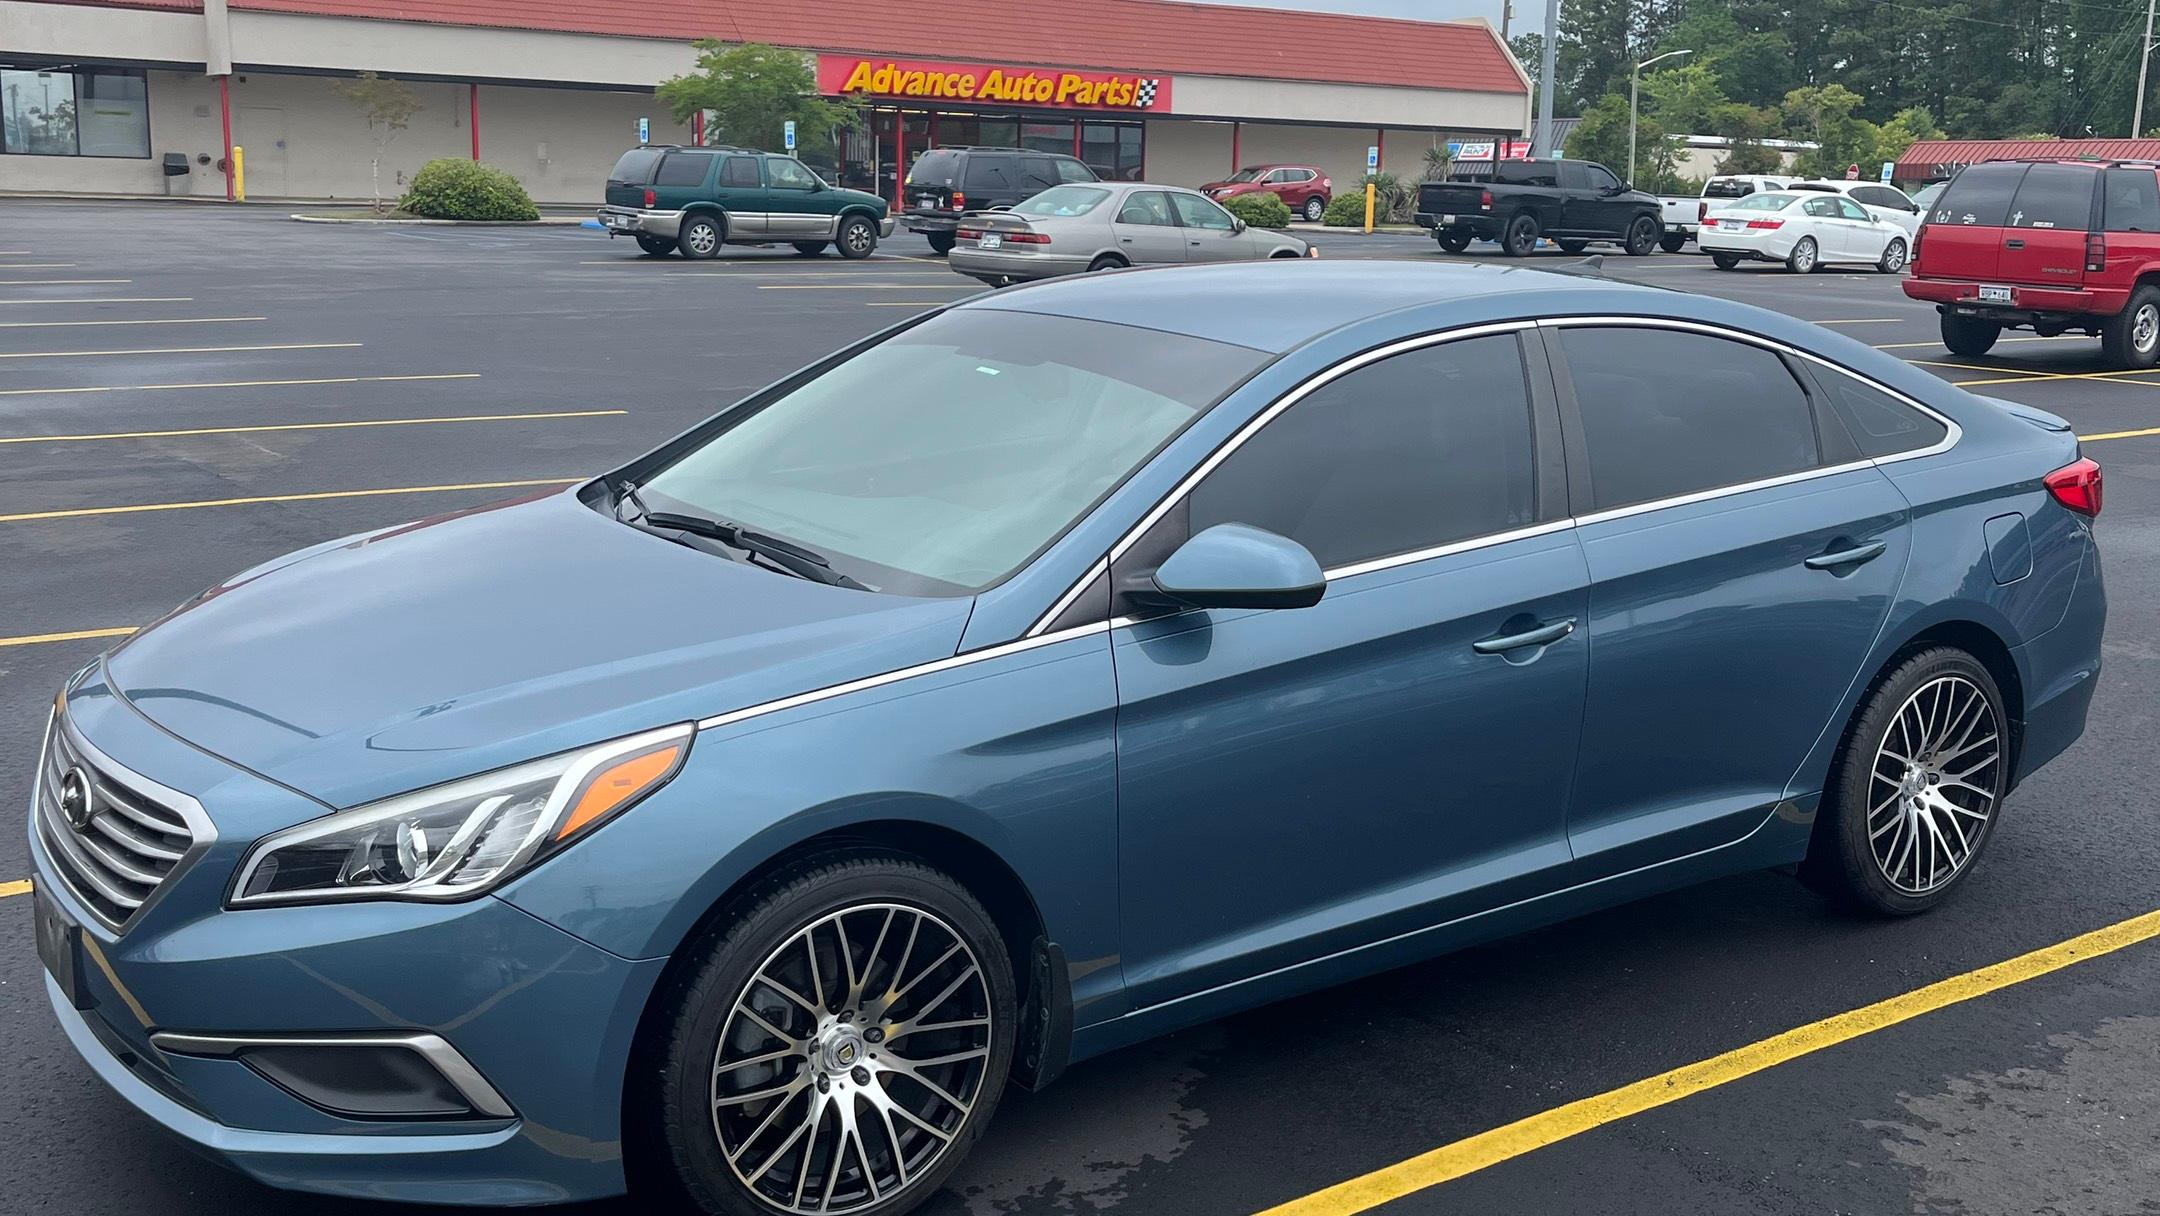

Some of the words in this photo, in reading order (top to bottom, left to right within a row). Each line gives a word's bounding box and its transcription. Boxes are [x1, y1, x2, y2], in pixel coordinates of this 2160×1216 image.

[843, 61, 975, 97] Advance
[977, 70, 1055, 103] Auto
[1055, 74, 1132, 107] Parts
